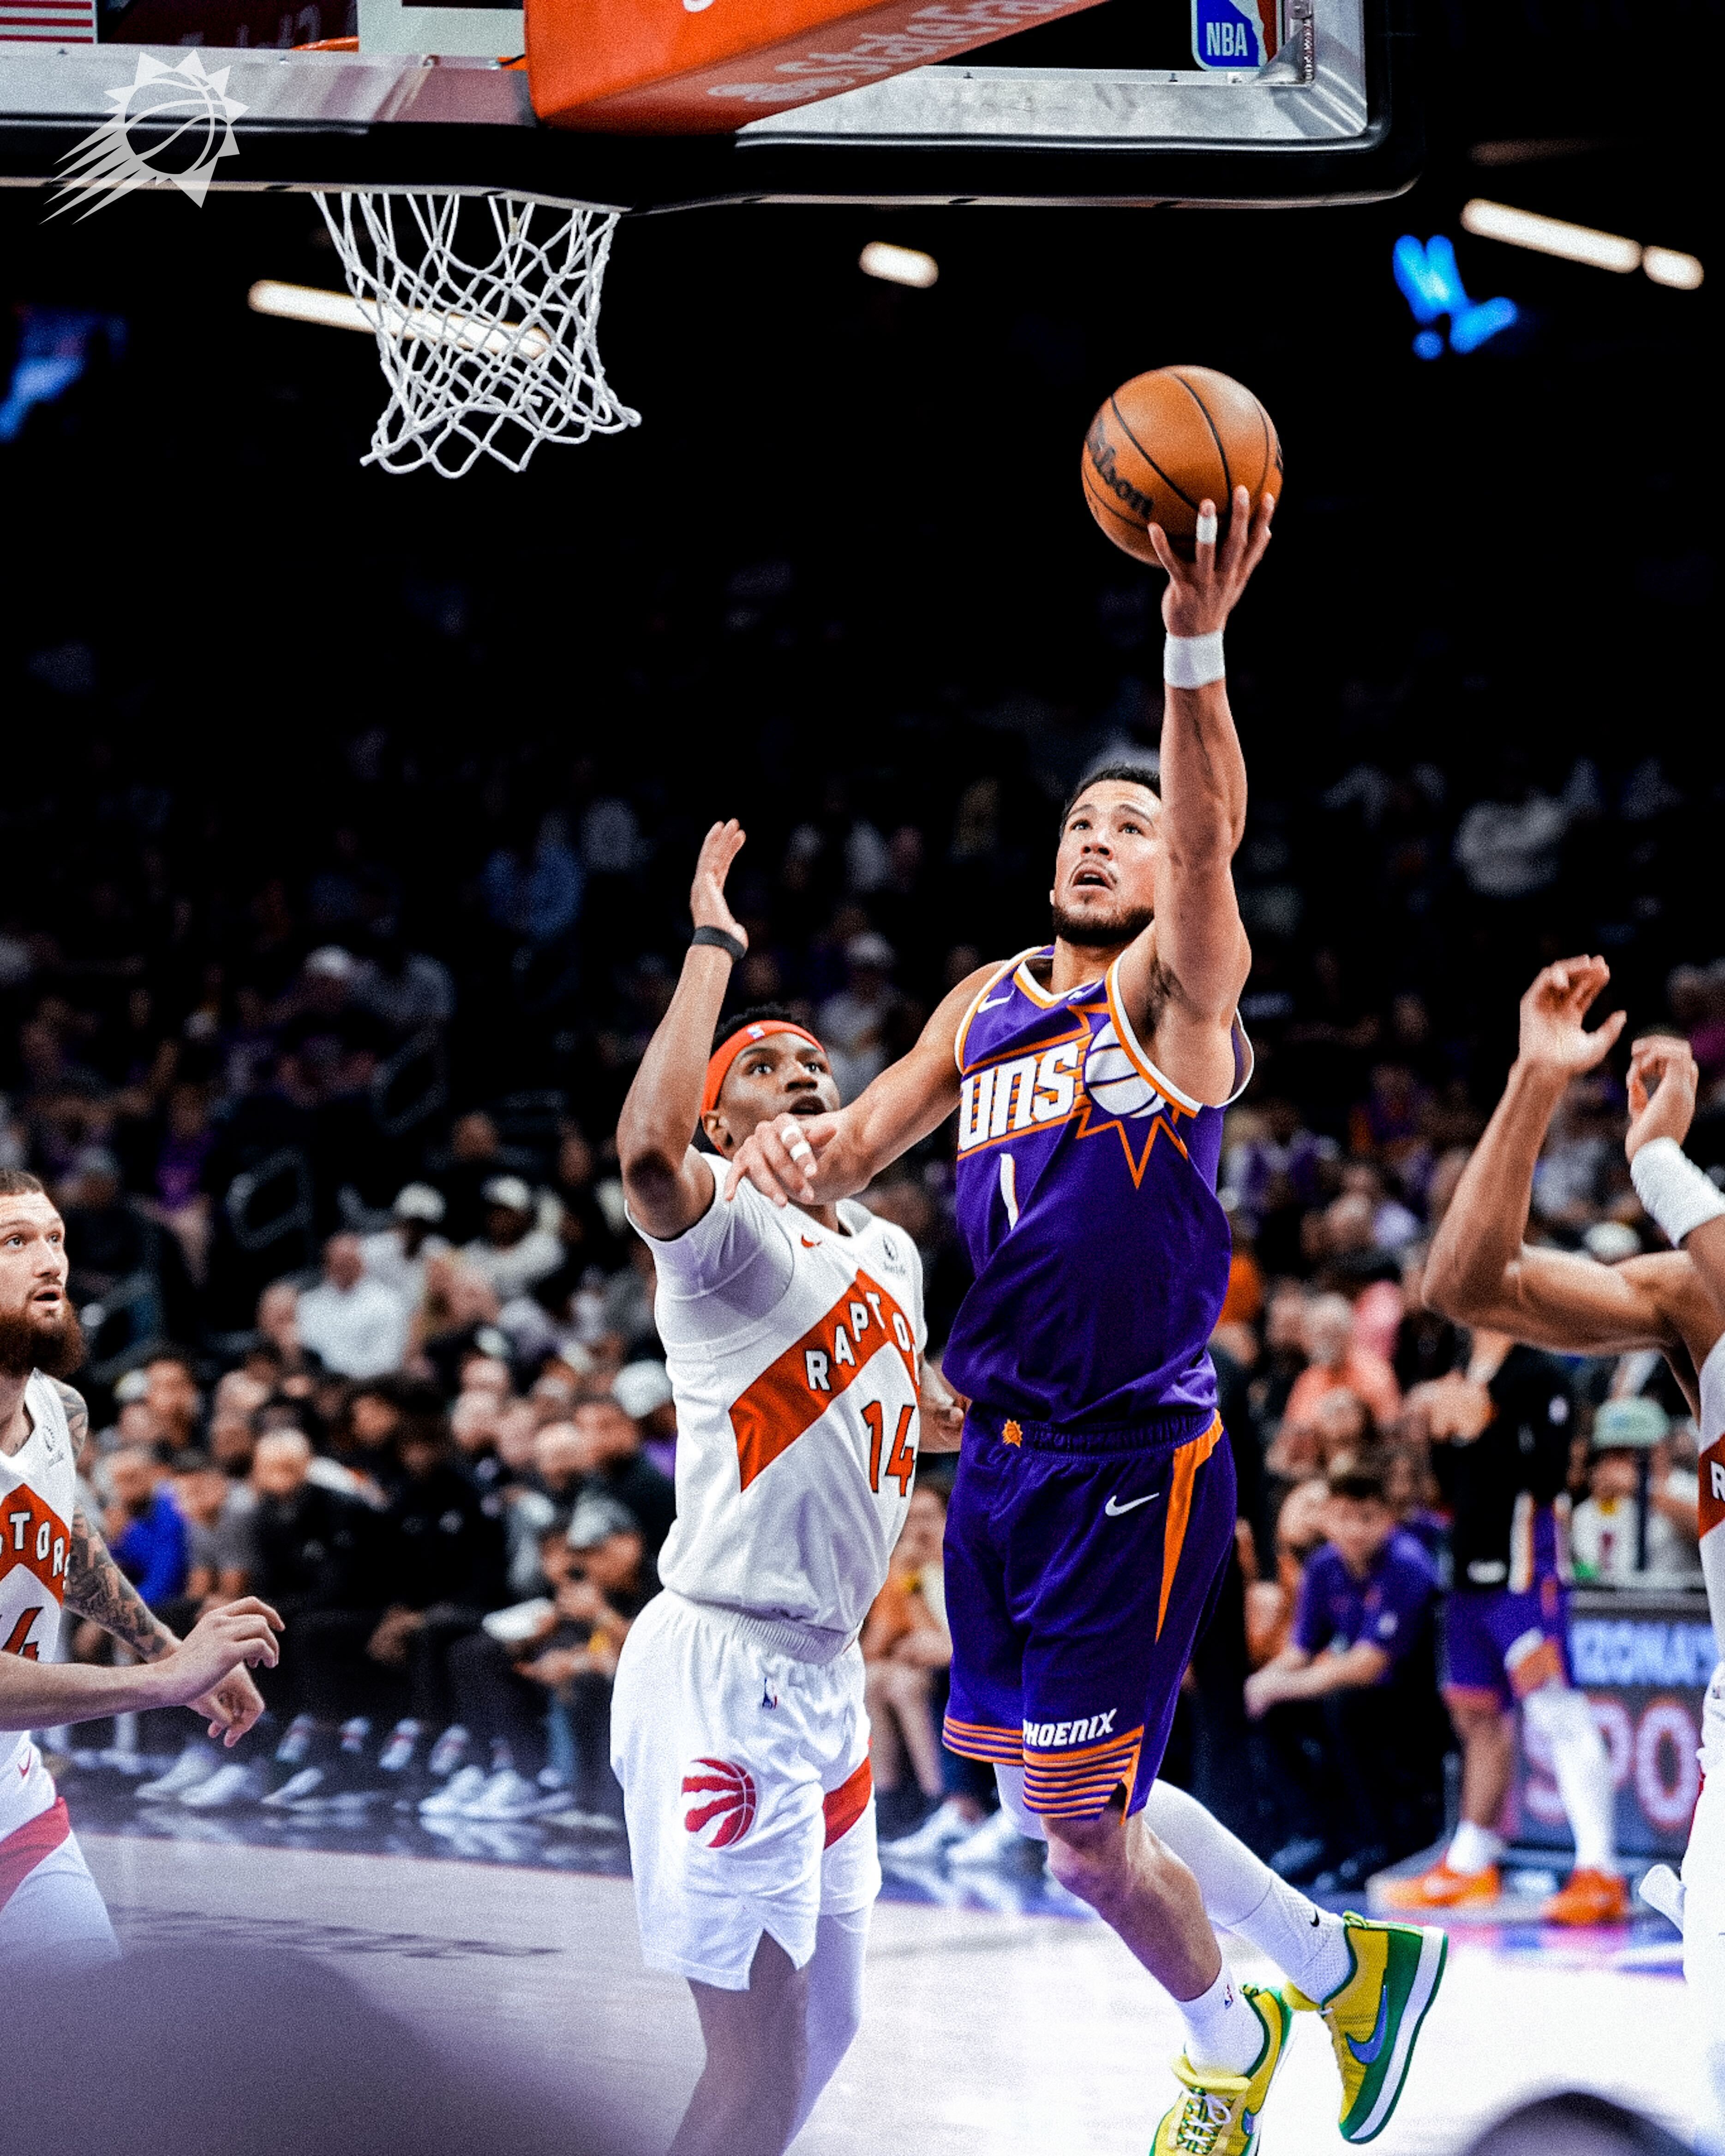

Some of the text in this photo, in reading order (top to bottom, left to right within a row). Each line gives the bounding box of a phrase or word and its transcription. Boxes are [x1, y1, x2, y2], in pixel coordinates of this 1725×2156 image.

[1205, 22, 1248, 56] NBA
[1000, 1153, 1020, 1231] 1
[805, 1291, 920, 1391] RAPTO
[861, 1400, 916, 1497] 14
[0, 1511, 70, 1590] TOR
[0, 1606, 44, 1661] 4
